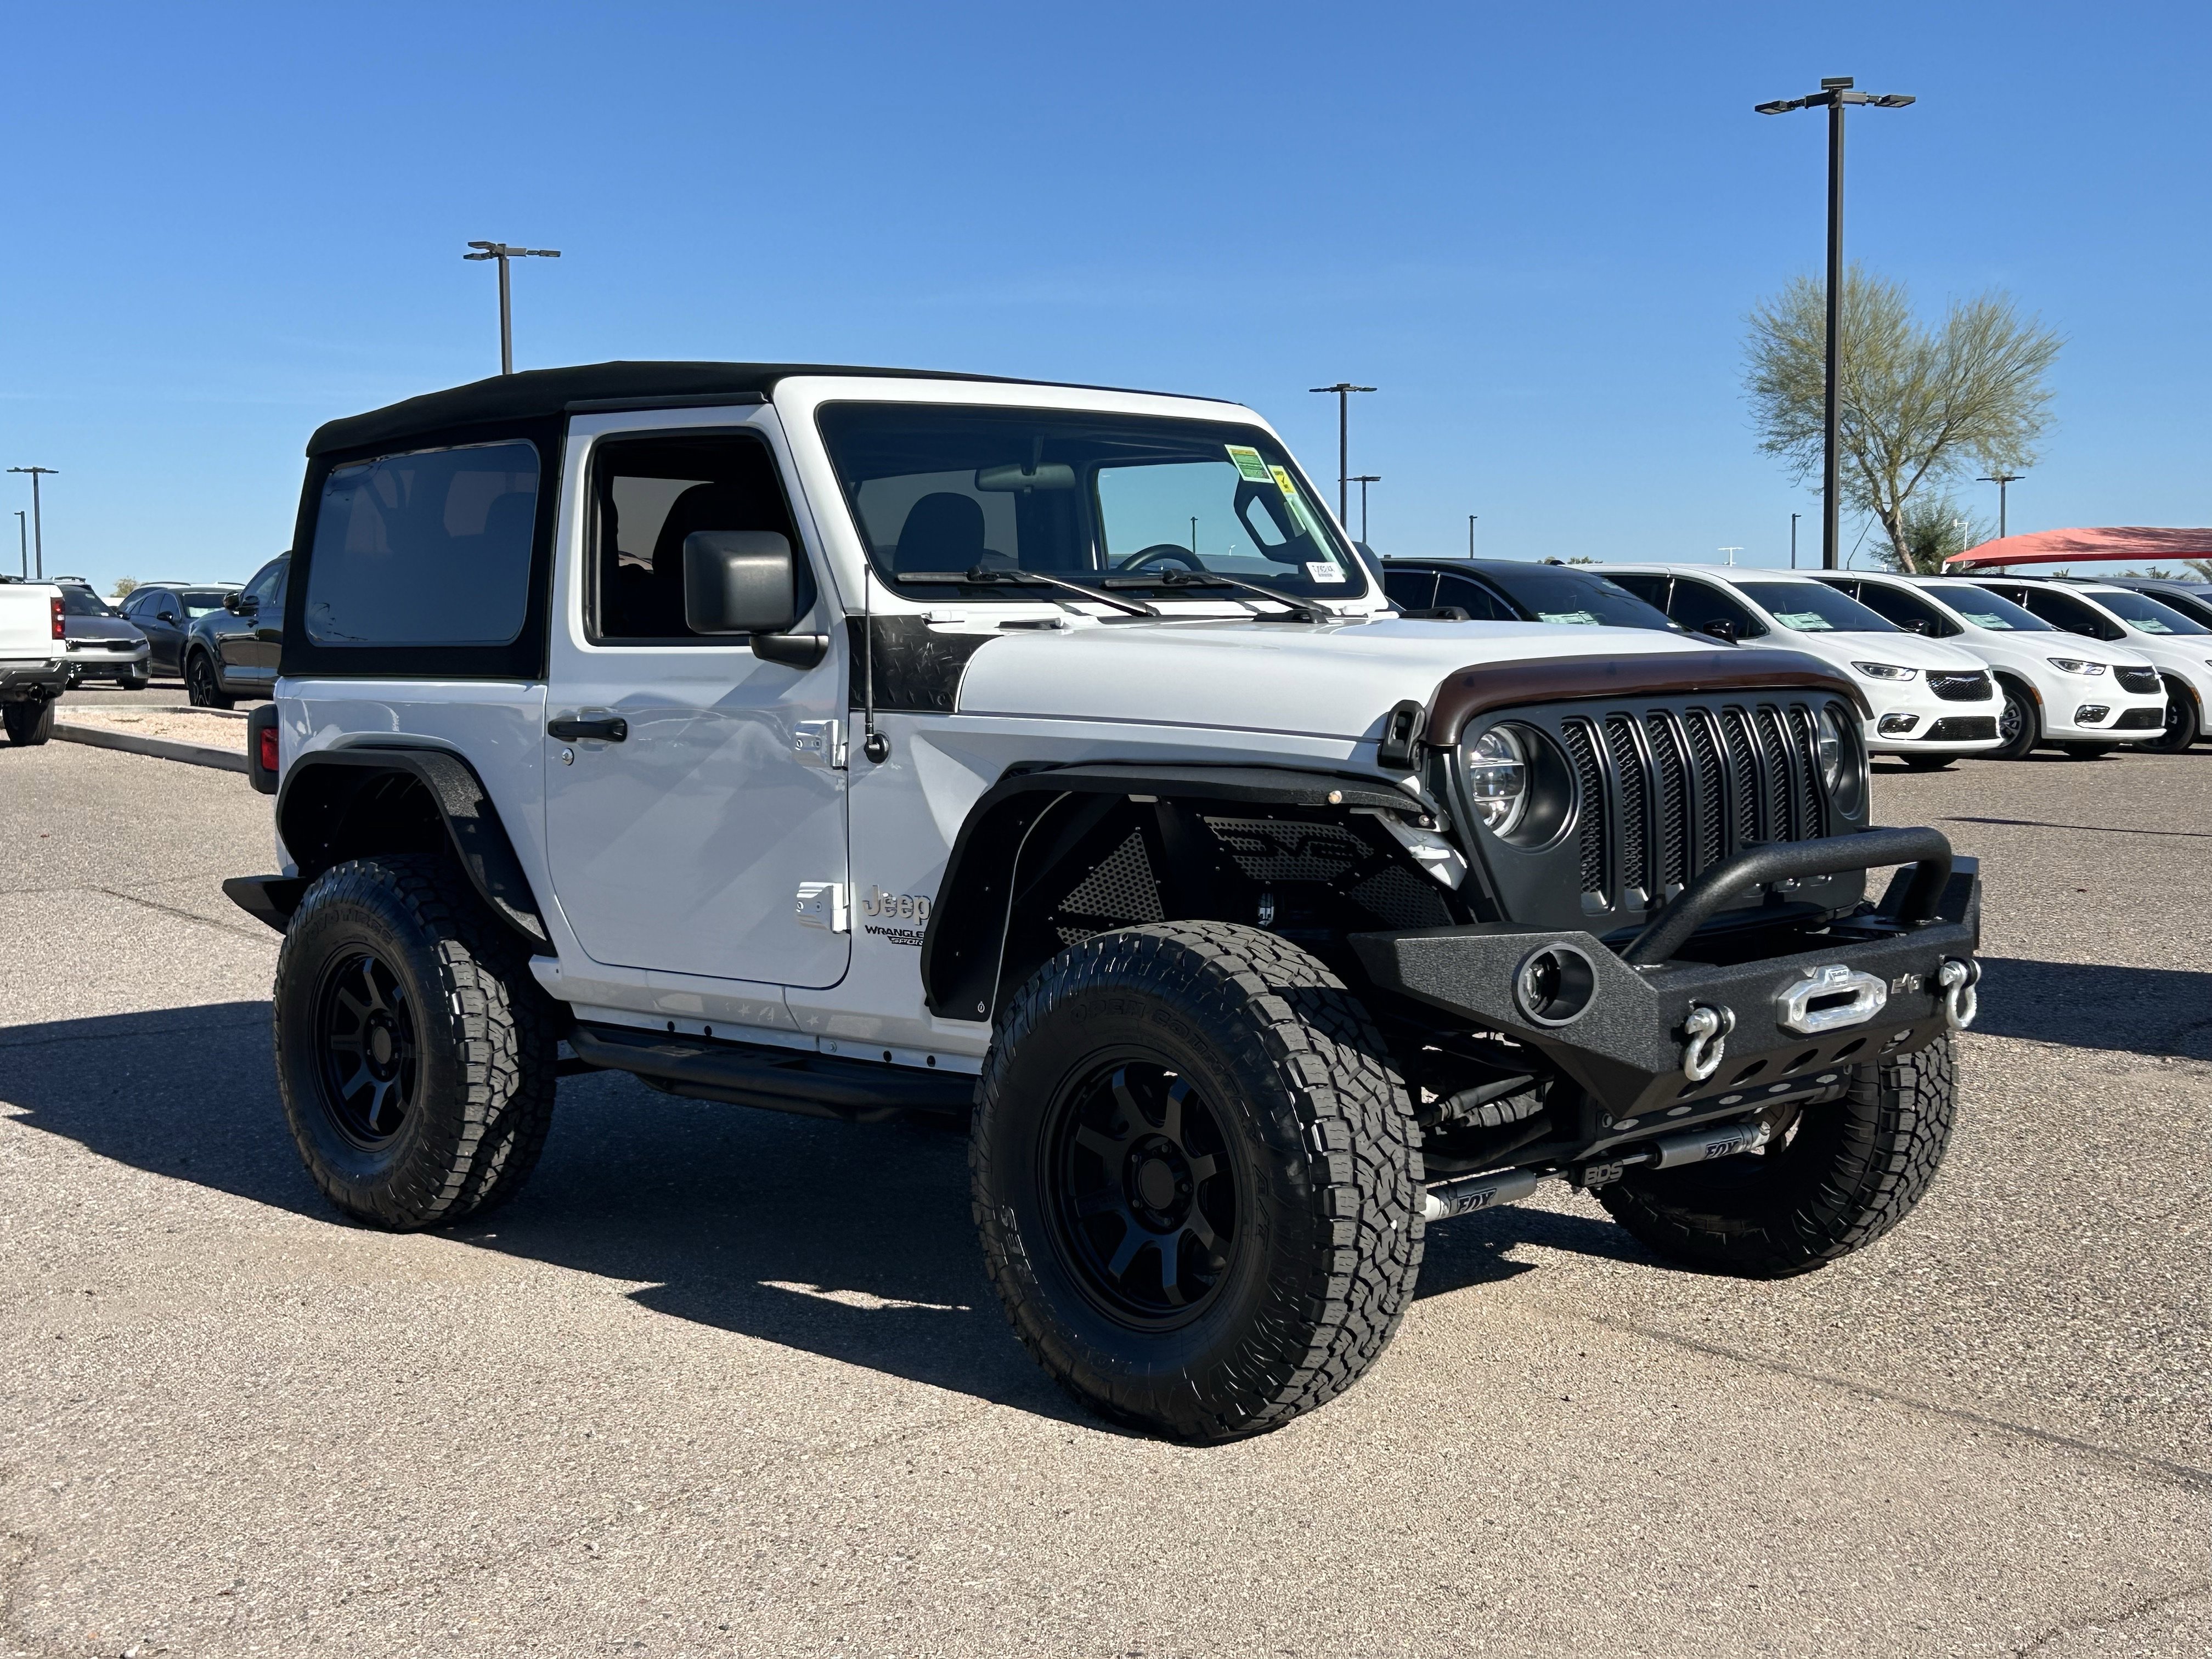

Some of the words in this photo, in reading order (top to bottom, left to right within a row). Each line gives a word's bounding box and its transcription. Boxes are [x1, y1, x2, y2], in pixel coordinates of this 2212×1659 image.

[862, 883, 932, 926] Jeep
[865, 924, 924, 938] WRANGLE
[1070, 998, 1146, 1025] OPEN
[1584, 1160, 1623, 1186] BDS
